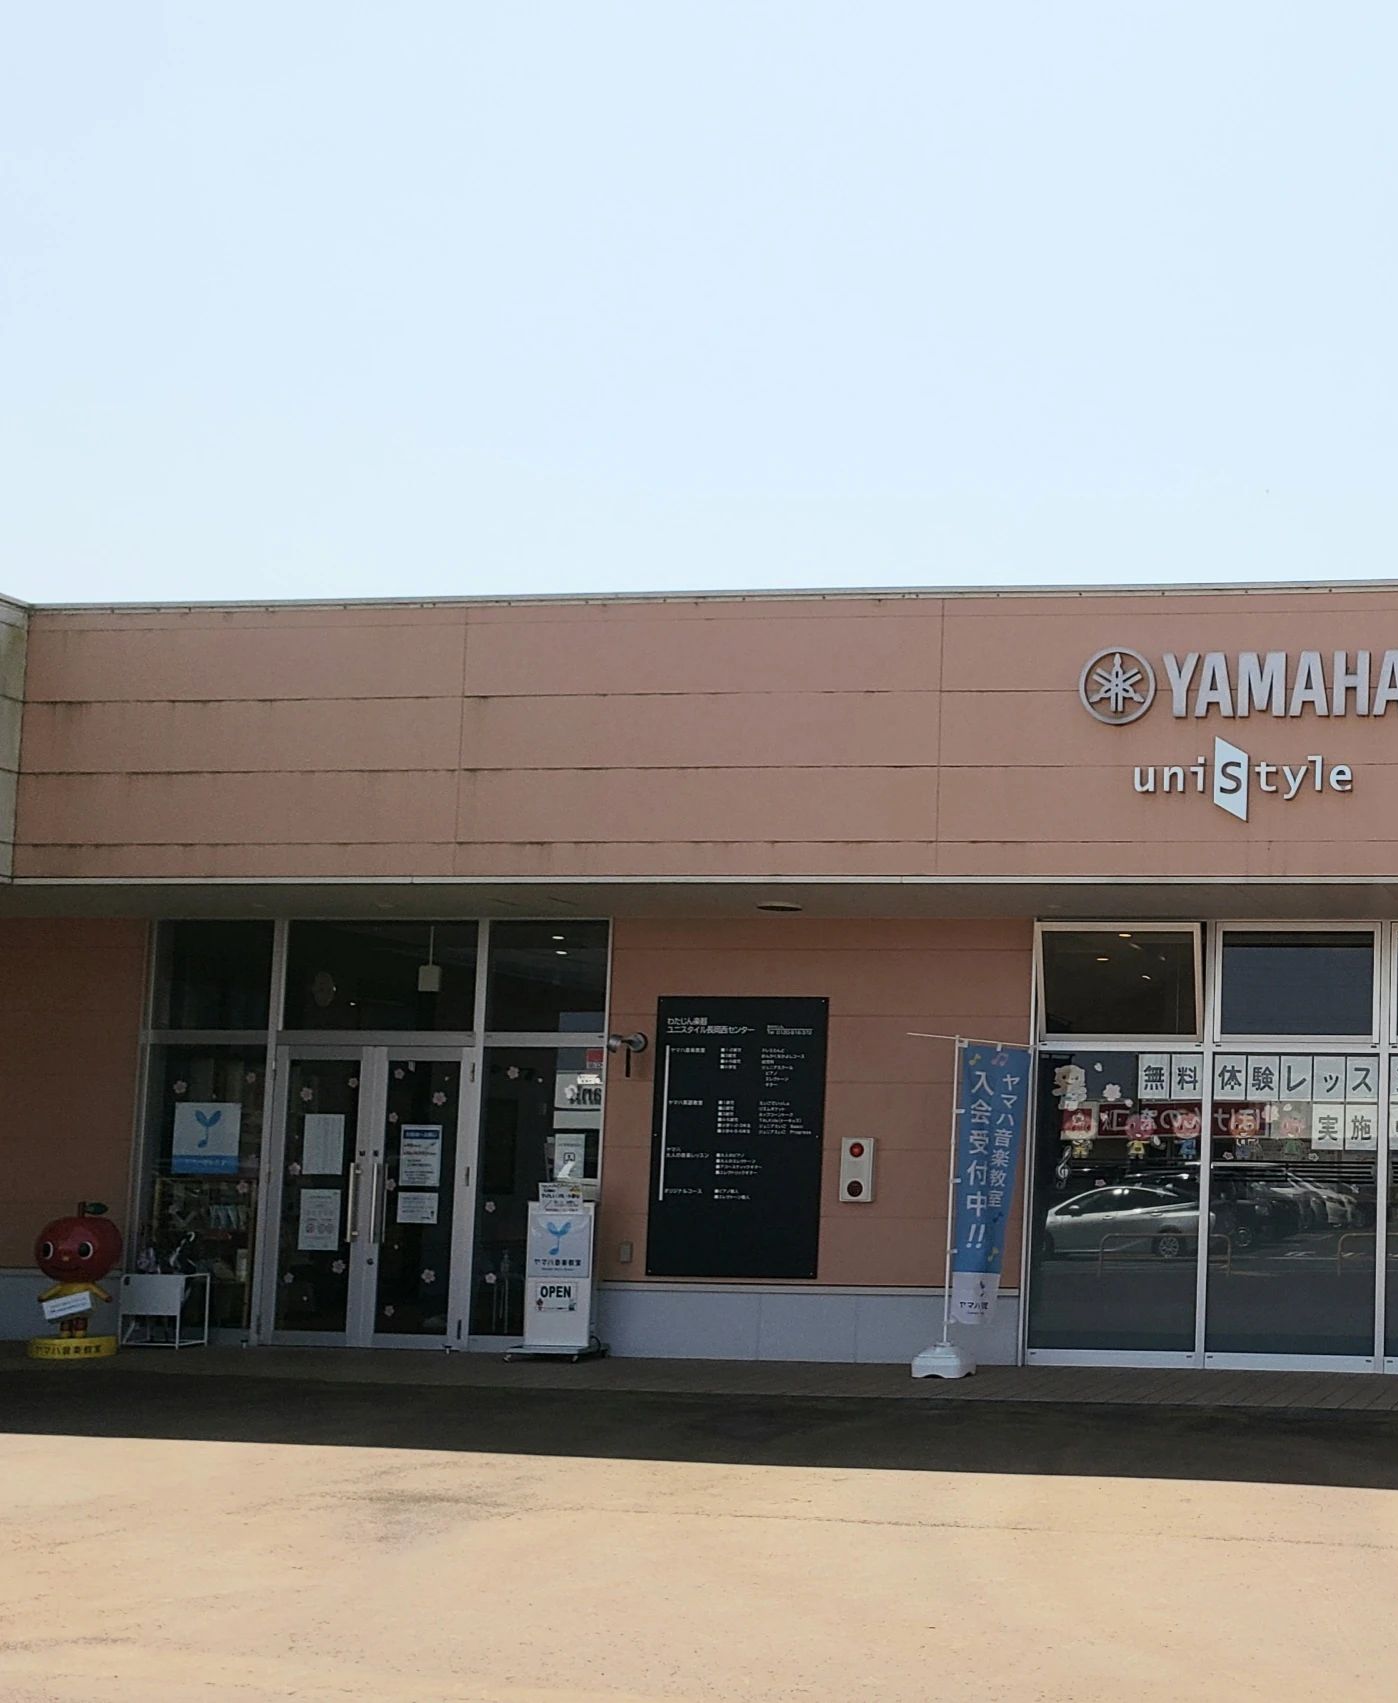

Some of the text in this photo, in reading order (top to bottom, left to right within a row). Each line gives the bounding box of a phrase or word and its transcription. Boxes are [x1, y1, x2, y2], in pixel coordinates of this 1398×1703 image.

[987, 1073, 1021, 1209] ヤマハ音楽教室
[540, 1285, 571, 1298] OPEN
